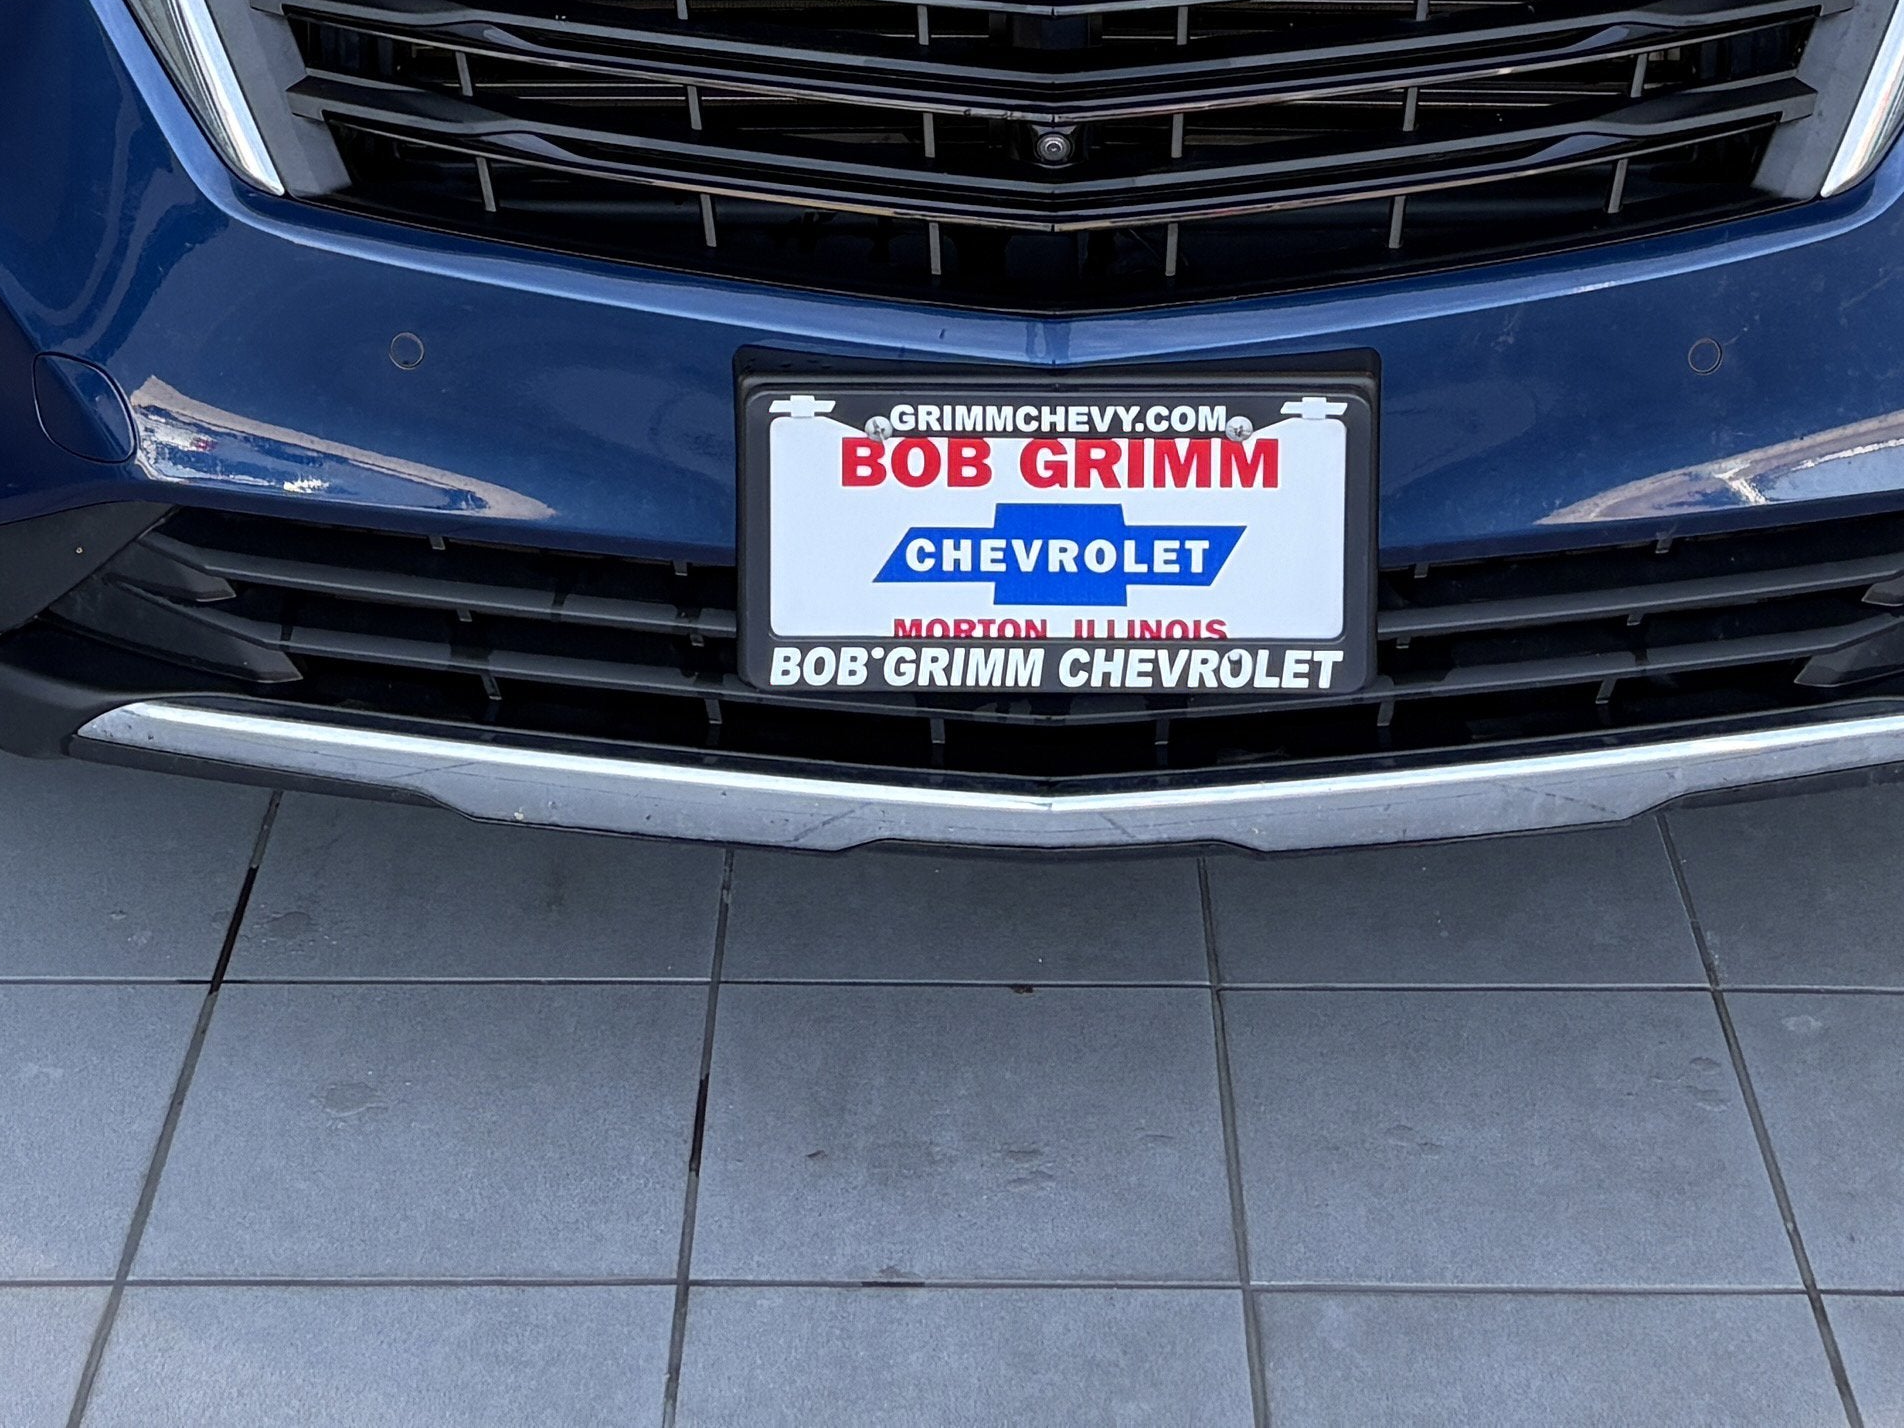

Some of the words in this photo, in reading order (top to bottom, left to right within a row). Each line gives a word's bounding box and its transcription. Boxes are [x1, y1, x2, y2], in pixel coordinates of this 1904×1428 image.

[890, 404, 1227, 433] GRIMMCHEVY.COM
[842, 436, 992, 487] BOB
[1020, 437, 1279, 489] GRIMM
[905, 538, 1210, 573] CHEVROLET
[894, 619, 1047, 639] MORTON
[770, 646, 869, 686] BOB
[884, 647, 1045, 687] GRIMM
[1058, 648, 1344, 689] CHEVROLET
